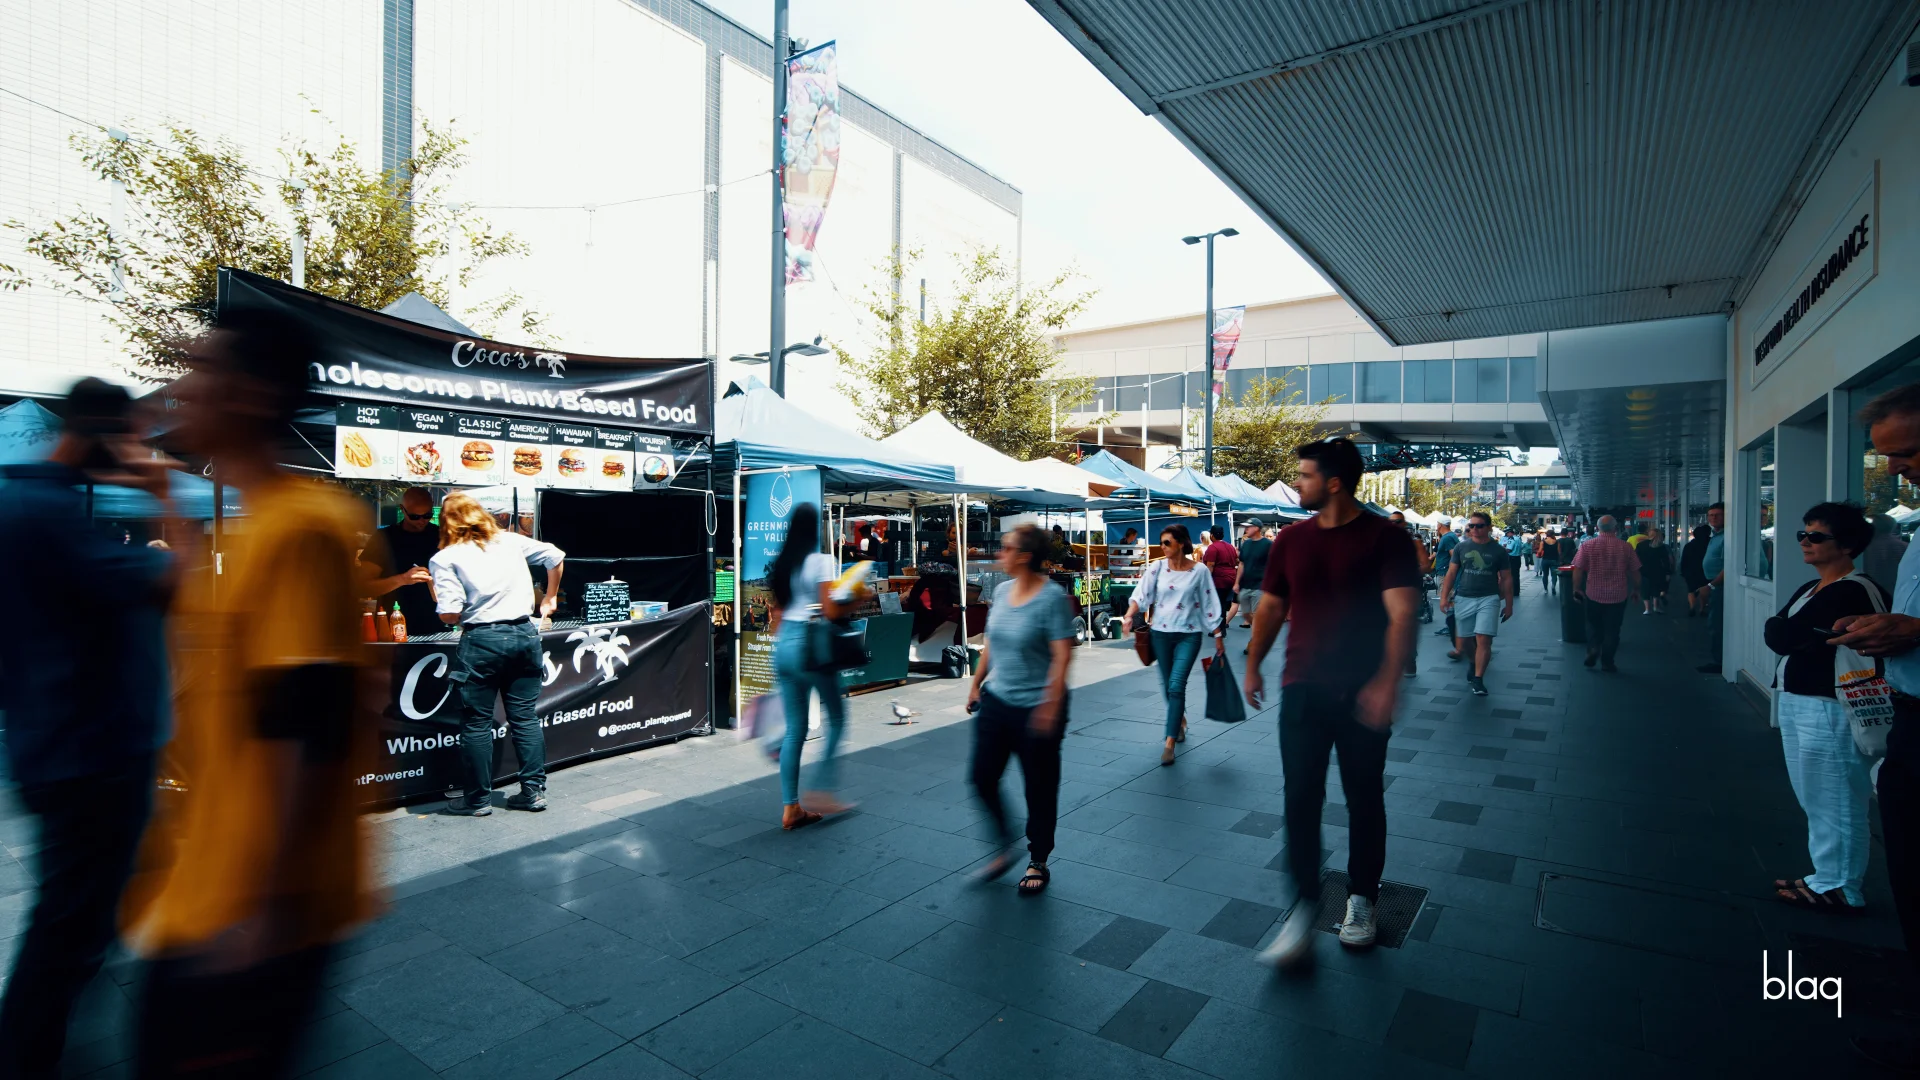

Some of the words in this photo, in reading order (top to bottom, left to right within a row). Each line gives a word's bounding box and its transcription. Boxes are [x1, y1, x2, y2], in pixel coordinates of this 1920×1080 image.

[1783, 286, 1810, 335] HEALTH
[1811, 213, 1870, 305] INSURANCE
[452, 341, 530, 369] Coco's
[357, 406, 379, 416] HOT
[558, 390, 637, 417] Based
[642, 399, 697, 424] Food
[356, 415, 380, 425] Chips
[411, 412, 444, 423] VEGAN
[416, 422, 438, 430] Gyros
[458, 418, 502, 429] CLASSIC
[458, 427, 502, 438] Cheeseburger
[509, 424, 549, 434] AMERICAN
[556, 428, 592, 438] HAWAIIAN
[509, 431, 549, 441] Cheeseburger
[563, 435, 584, 443] Burger
[598, 432, 632, 442] BREAKFAST
[639, 436, 667, 445] NOURISH
[605, 440, 624, 448] Burger
[381, 456, 395, 465] $5
[486, 473, 501, 482] $10
[748, 521, 791, 531] GREENMA
[764, 532, 789, 542] VALLE
[1845, 688, 1881, 699] NEVER
[1848, 697, 1887, 708] WORLD
[552, 703, 596, 725] Based
[598, 696, 634, 715] Food
[1854, 706, 1895, 717] CRUELT
[1859, 717, 1882, 727] LIFE
